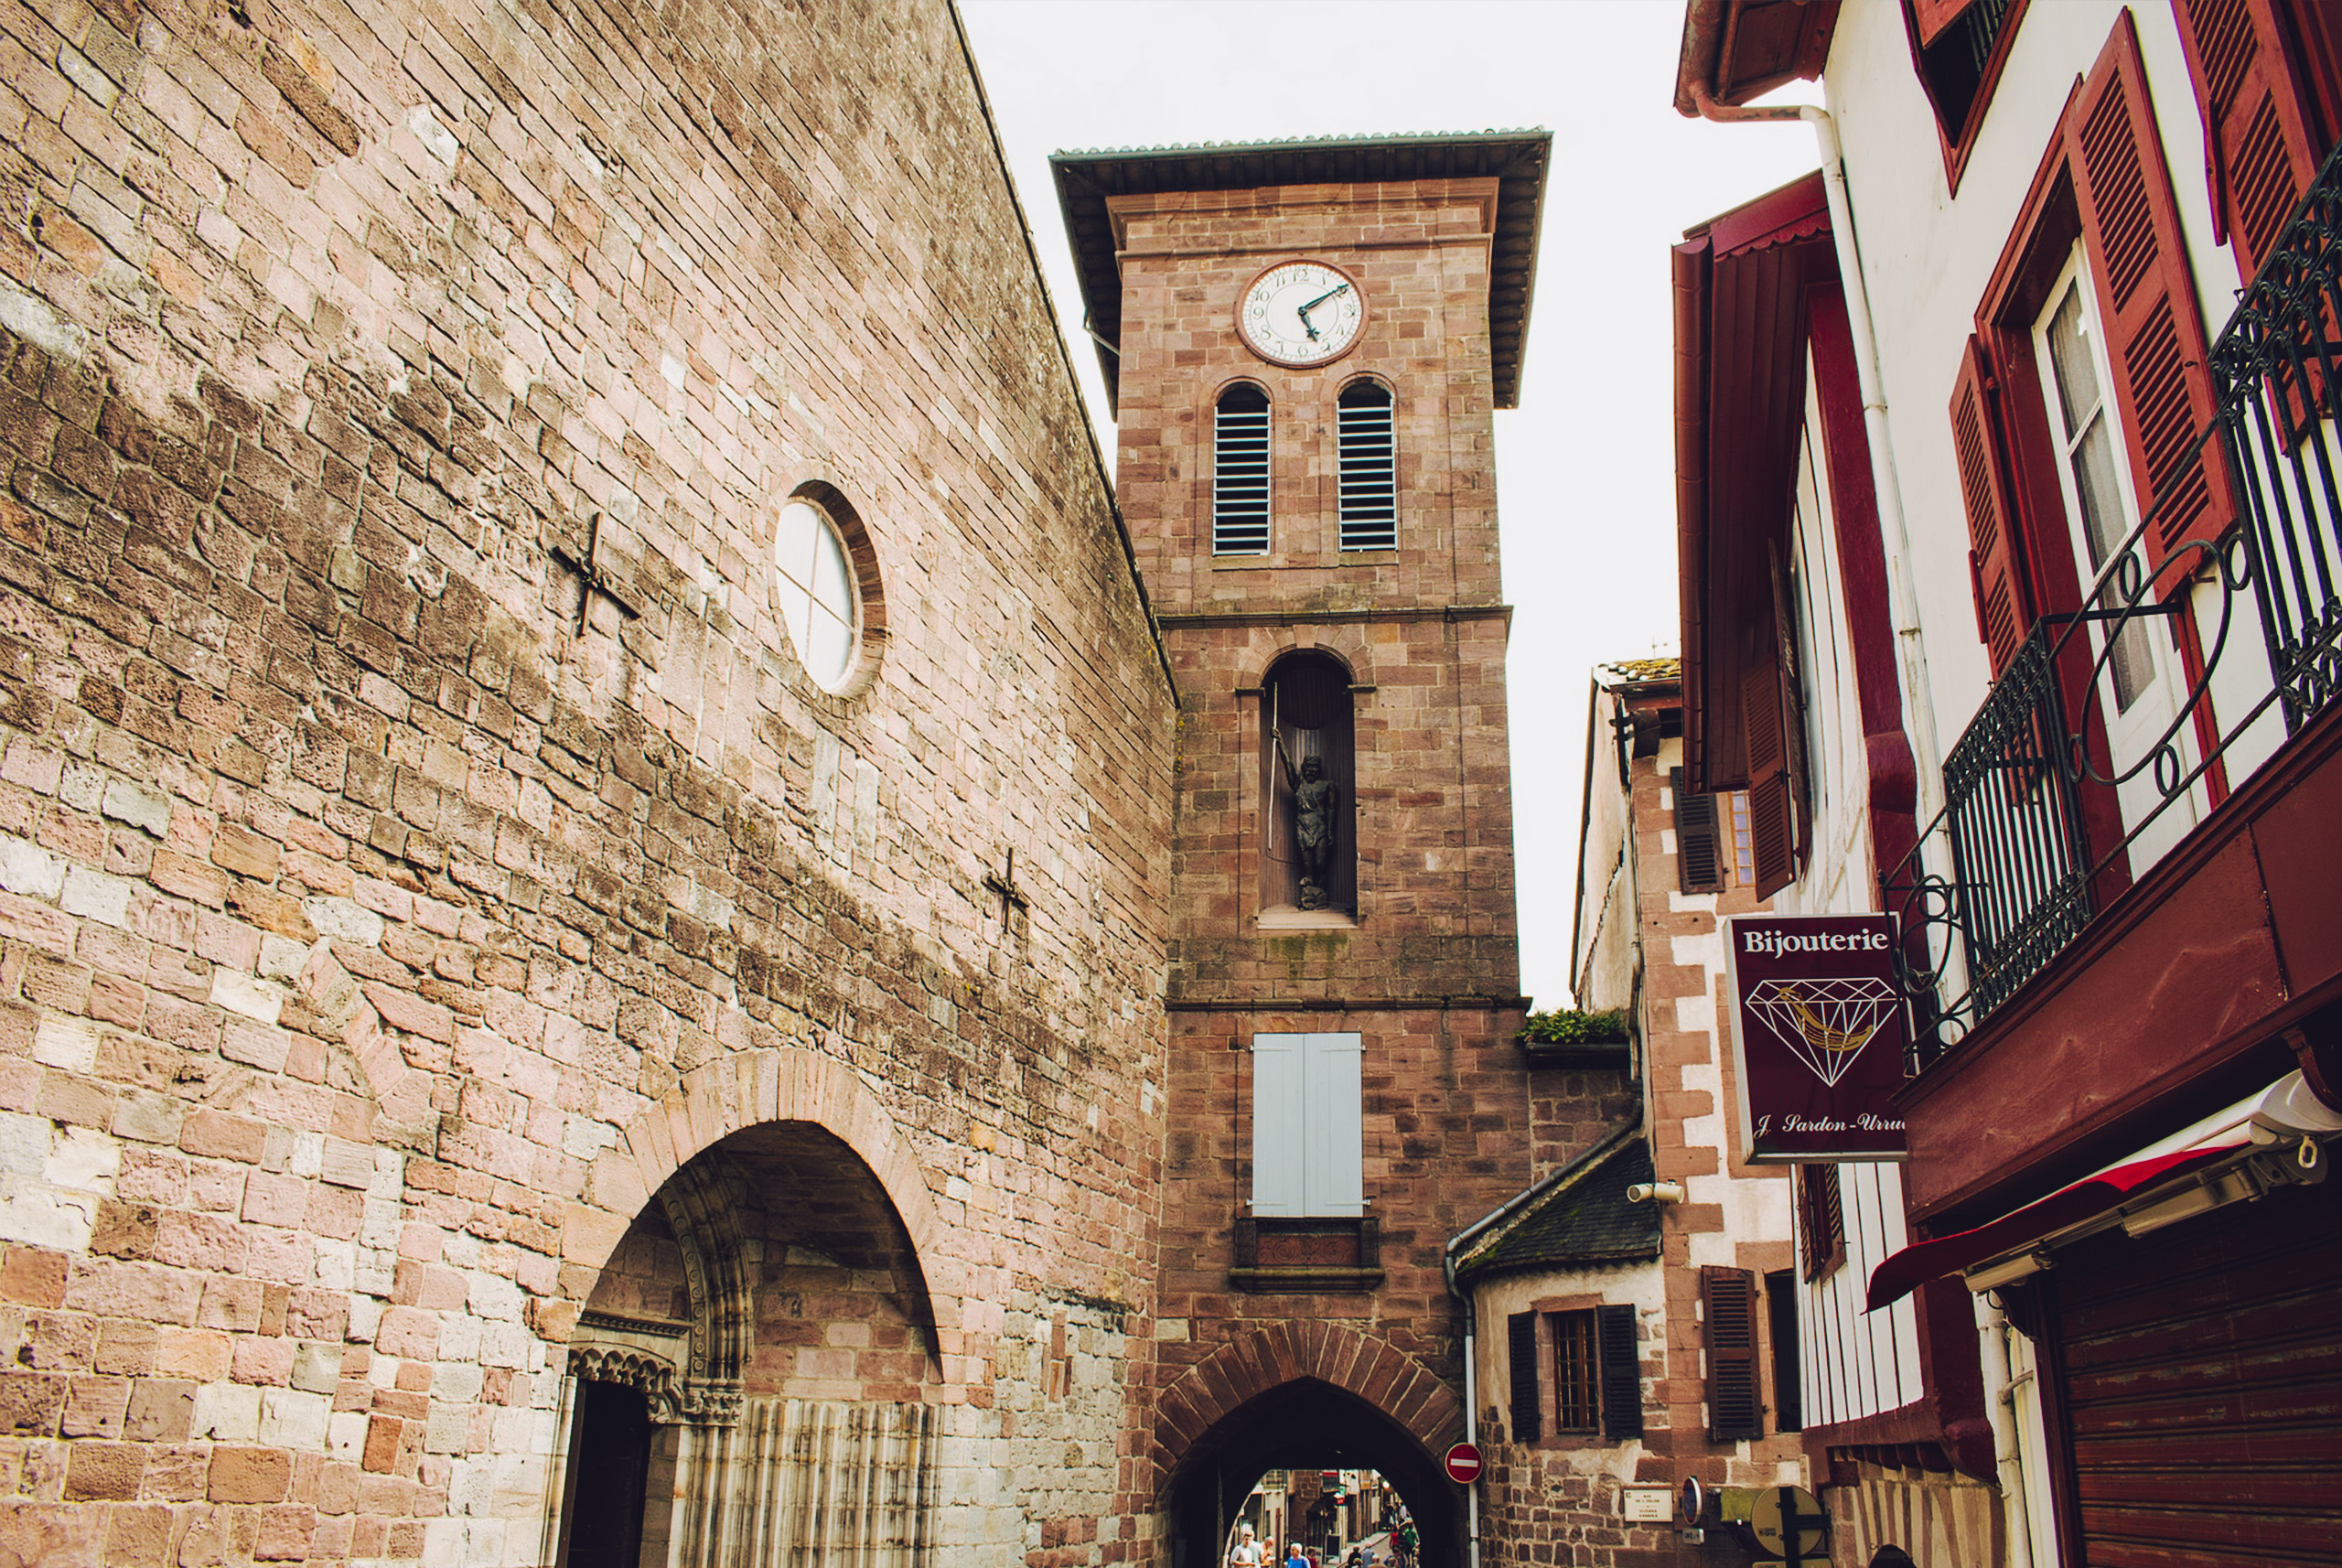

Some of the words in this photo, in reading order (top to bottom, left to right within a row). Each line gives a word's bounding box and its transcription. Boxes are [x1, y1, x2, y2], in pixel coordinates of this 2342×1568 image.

[1276, 274, 1285, 287] 11
[1293, 269, 1309, 282] 12
[1255, 288, 1270, 301] 10
[1253, 306, 1264, 320] 9
[1344, 303, 1355, 318] 3
[1260, 324, 1272, 340] 8
[1297, 344, 1309, 357] 6
[1743, 928, 1888, 959] Bijouterie
